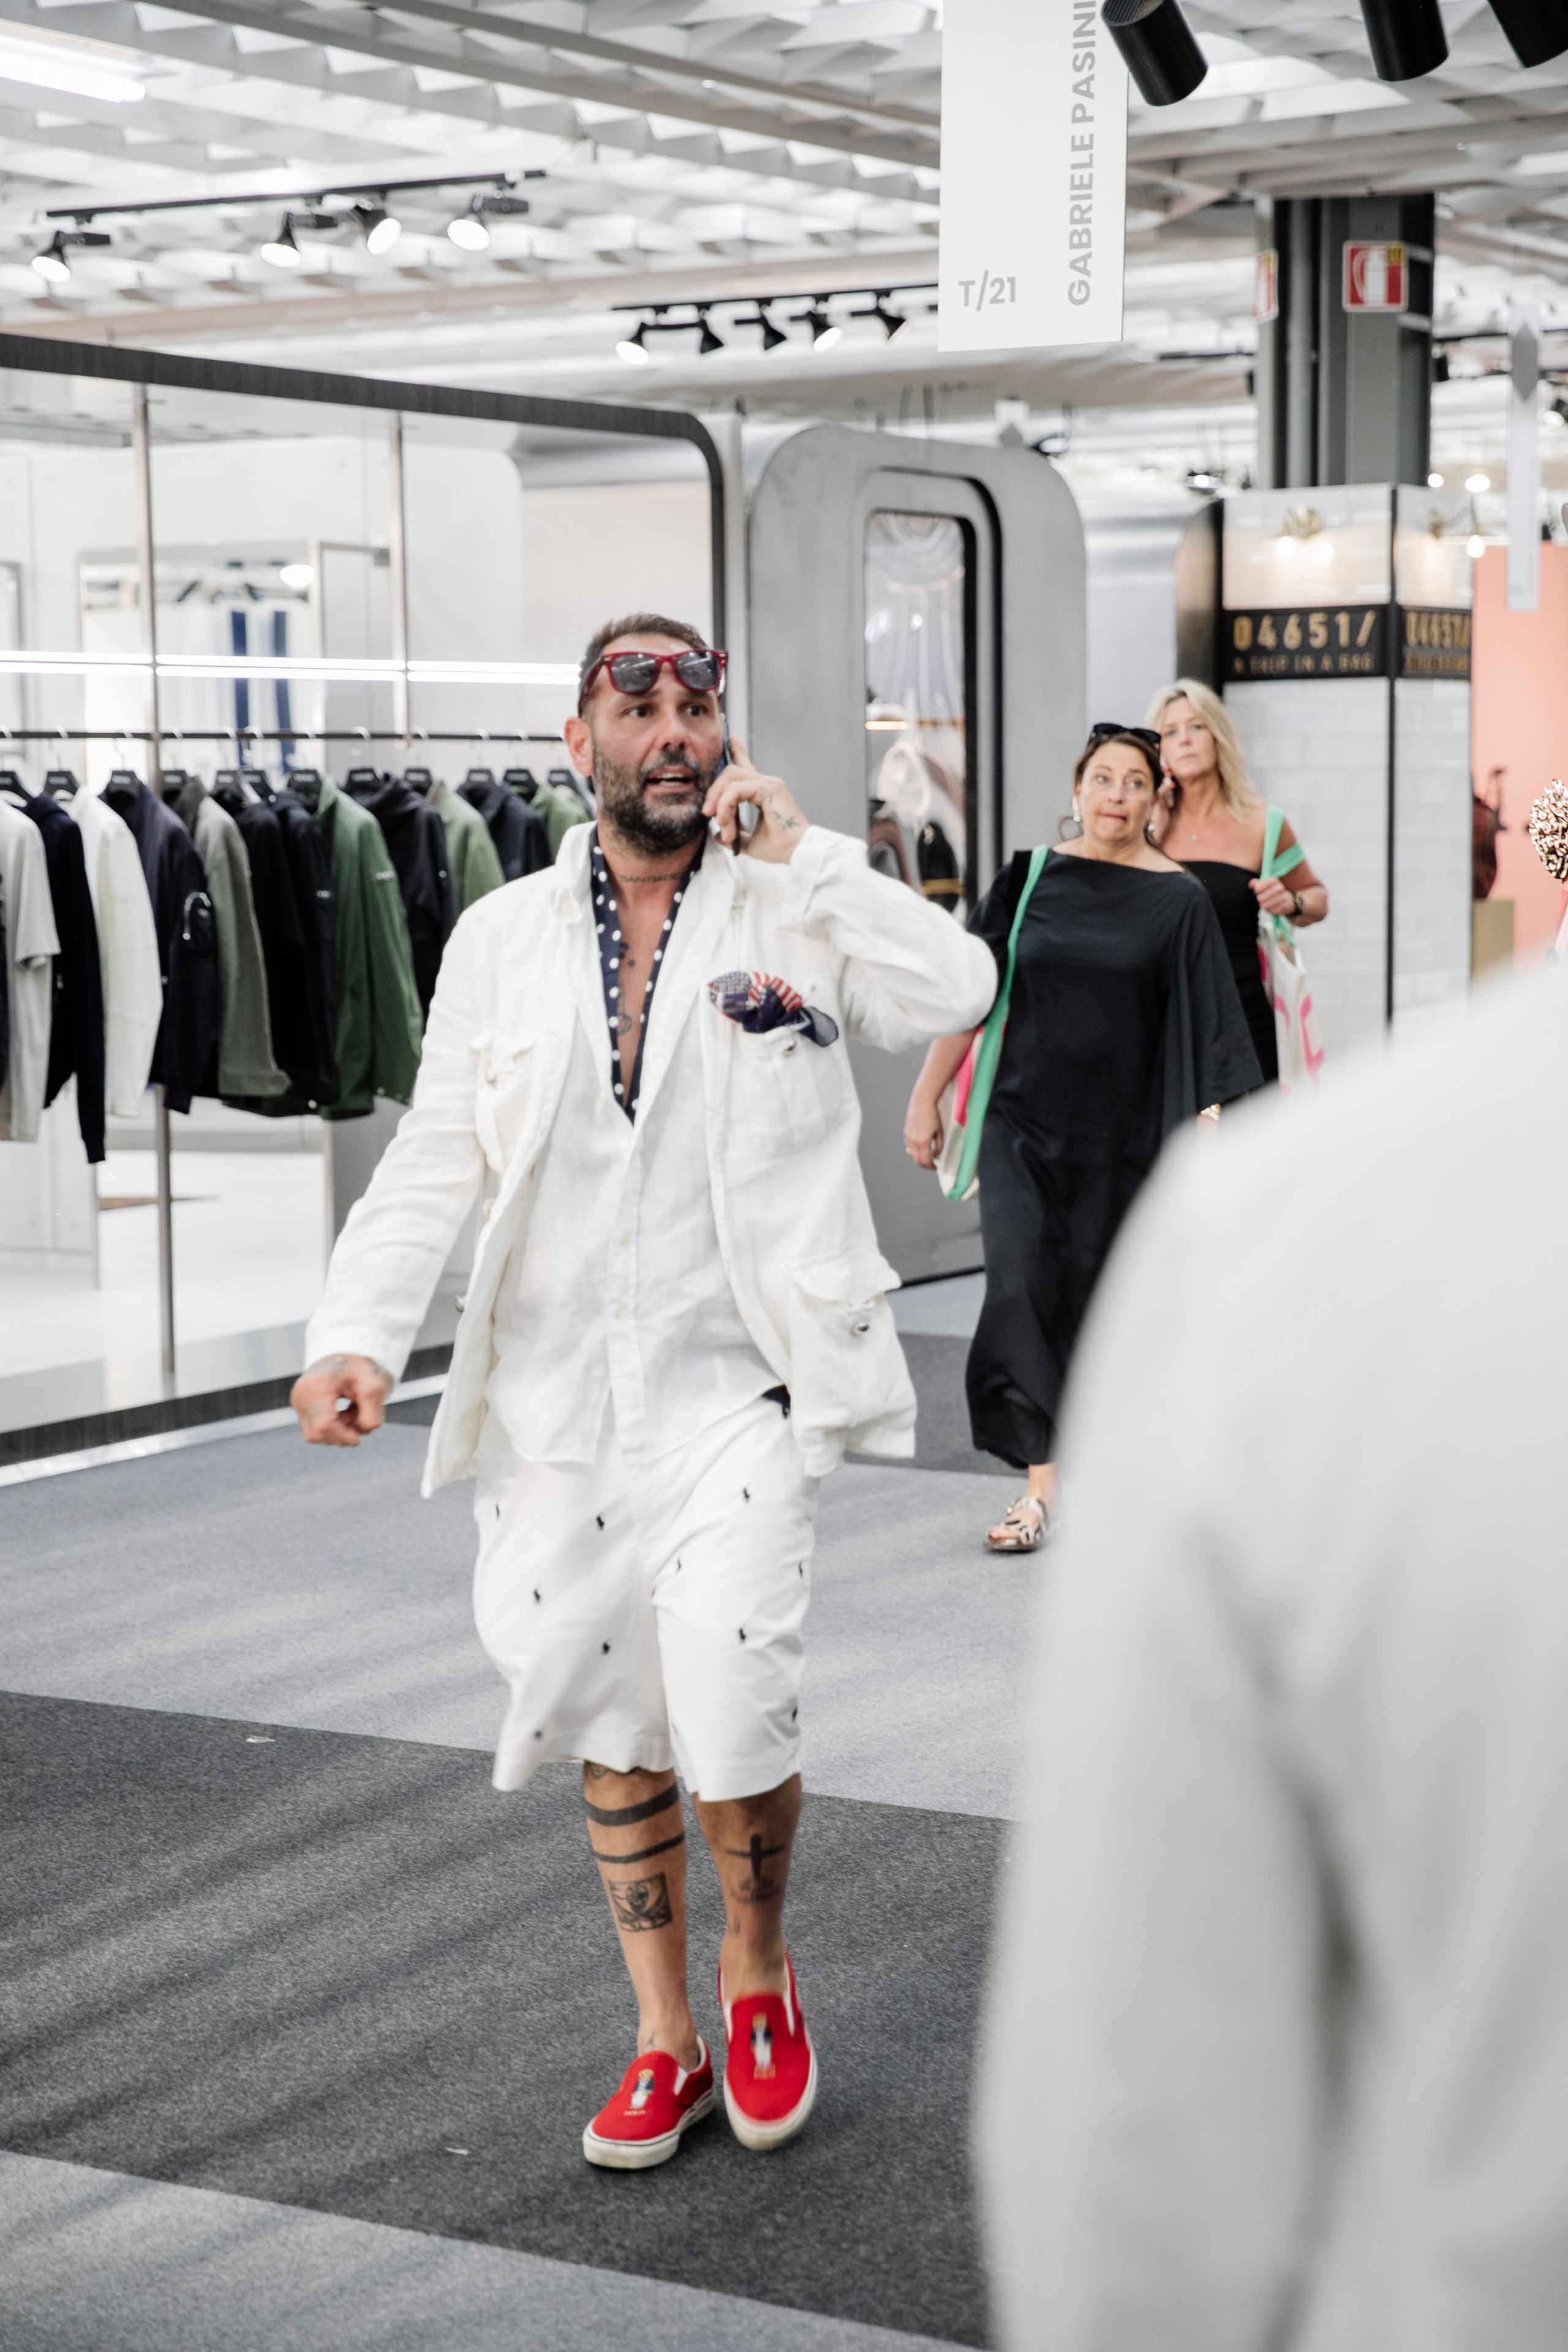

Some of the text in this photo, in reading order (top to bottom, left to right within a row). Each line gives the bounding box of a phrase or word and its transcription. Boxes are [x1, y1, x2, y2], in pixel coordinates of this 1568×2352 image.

[1068, 1, 1096, 306] GABRIELE PASINI
[959, 270, 1016, 311] T/21
[1233, 610, 1376, 651] 04651/
